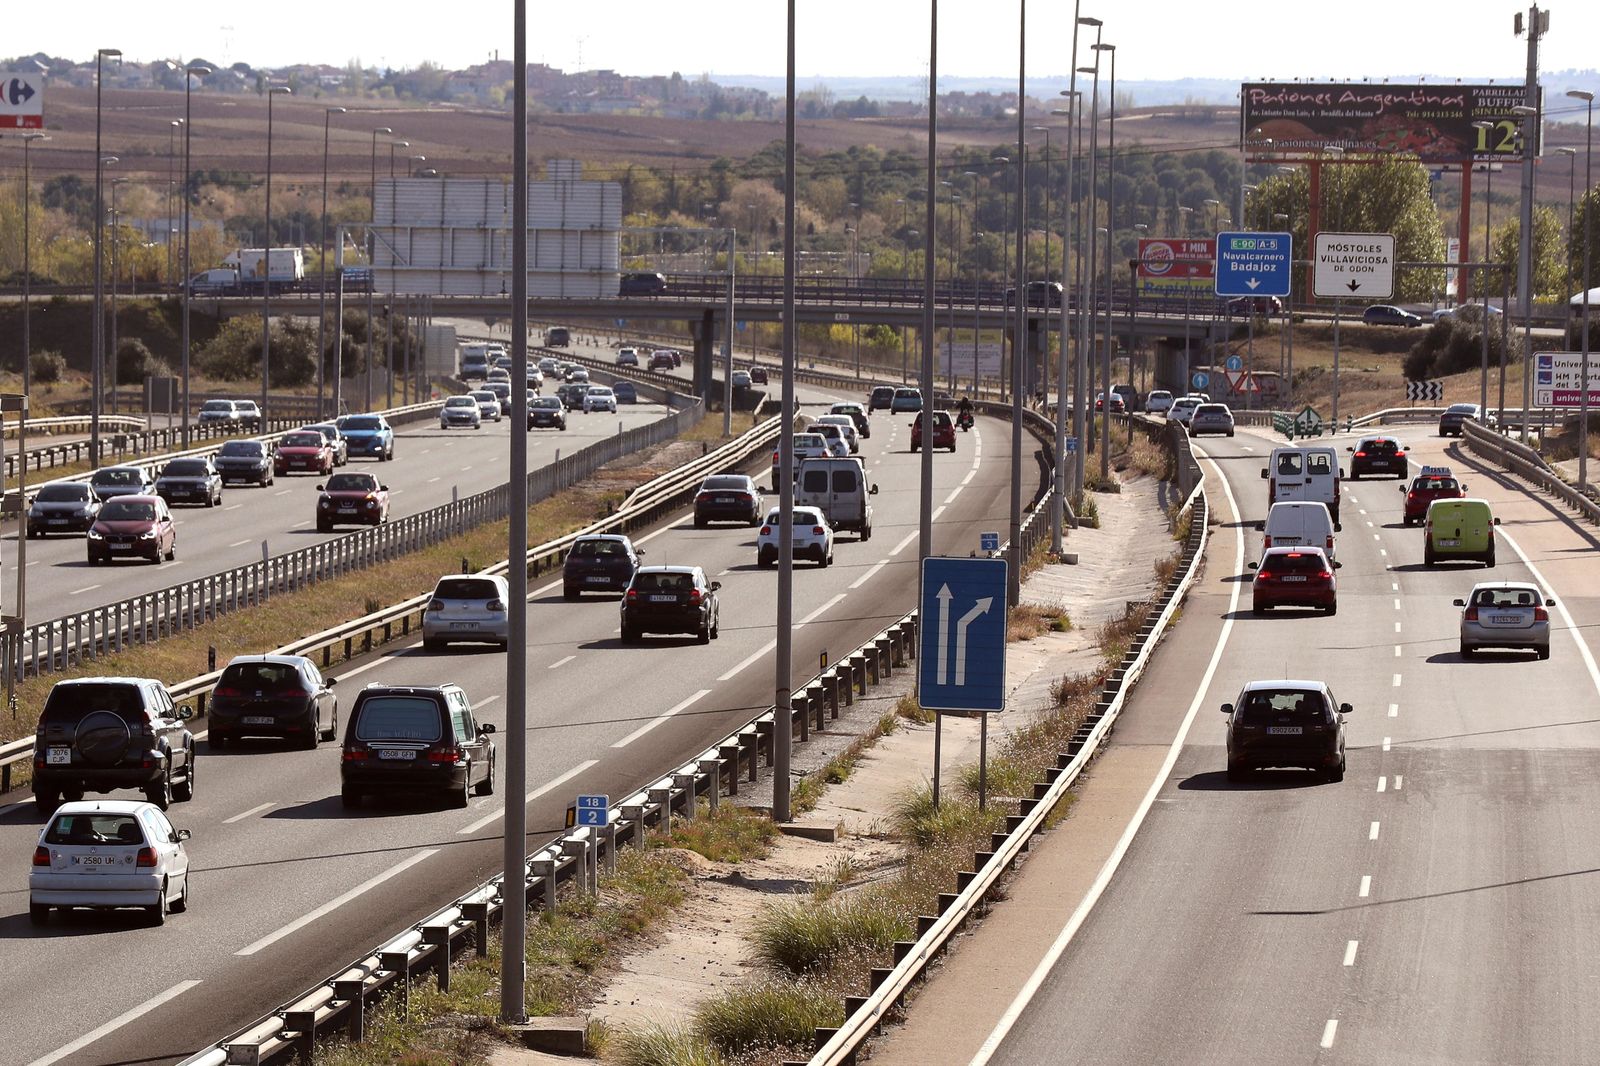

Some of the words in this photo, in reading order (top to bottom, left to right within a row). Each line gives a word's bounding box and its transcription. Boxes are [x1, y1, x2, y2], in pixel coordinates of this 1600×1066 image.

[1250, 88, 1331, 105] Pasiones
[1338, 90, 1464, 114] Argentinas
[1190, 243, 1207, 252] MIN
[1327, 243, 1382, 253] MÓSTOLES
[1223, 252, 1284, 260] Navalcarnero
[1321, 254, 1388, 264] VILLAVICIOSA
[1231, 262, 1276, 272] Badajoz
[586, 798, 599, 806] 18
[588, 811, 597, 823] 2
[84, 857, 102, 865] 2580
